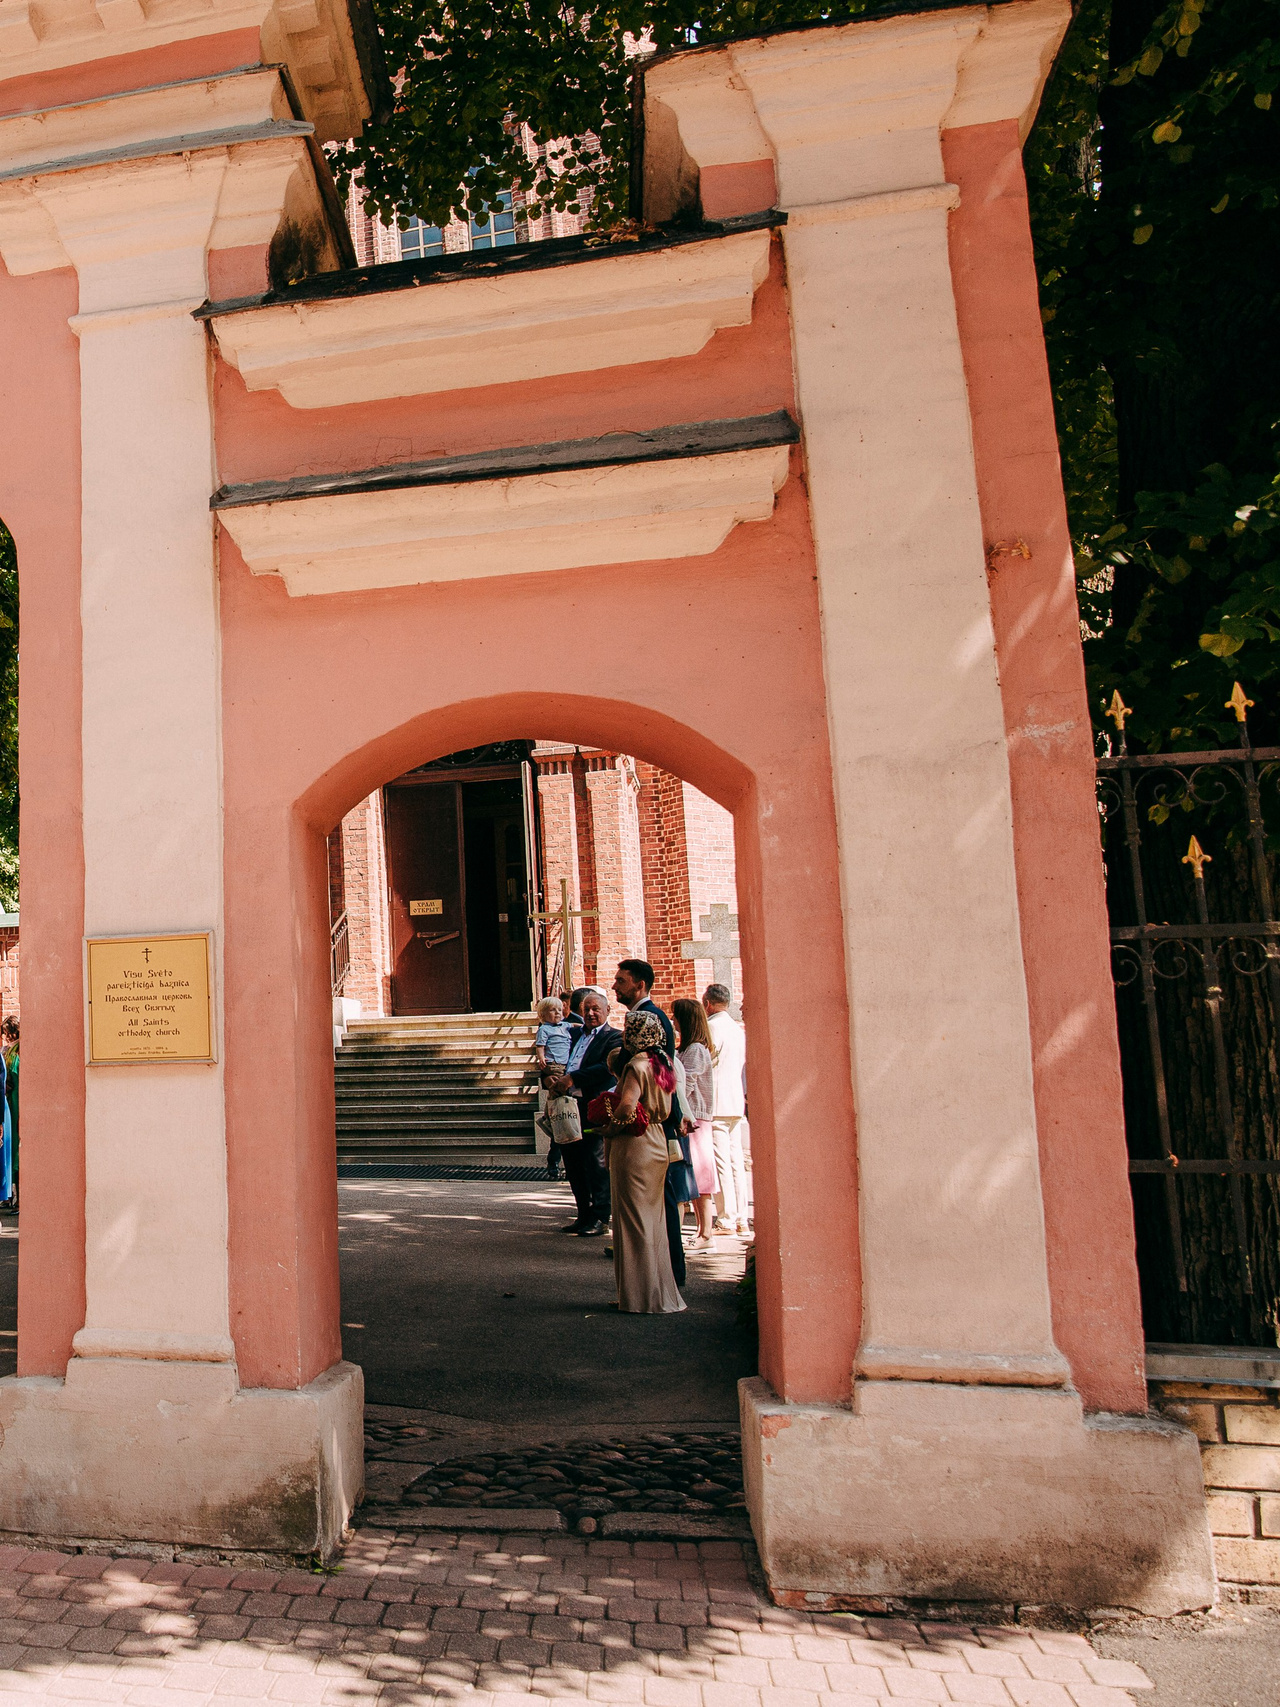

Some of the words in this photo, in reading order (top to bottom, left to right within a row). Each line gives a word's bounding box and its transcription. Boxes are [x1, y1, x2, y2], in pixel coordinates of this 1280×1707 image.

[123, 970, 143, 978] Visu
[105, 994, 157, 1004] Православная
[162, 994, 192, 1002] церковь
[122, 1004, 140, 1013] Всех
[144, 1004, 176, 1012] Святых
[143, 1018, 170, 1027] Saints
[118, 1029, 151, 1038] orthodox
[155, 1028, 180, 1036] church
